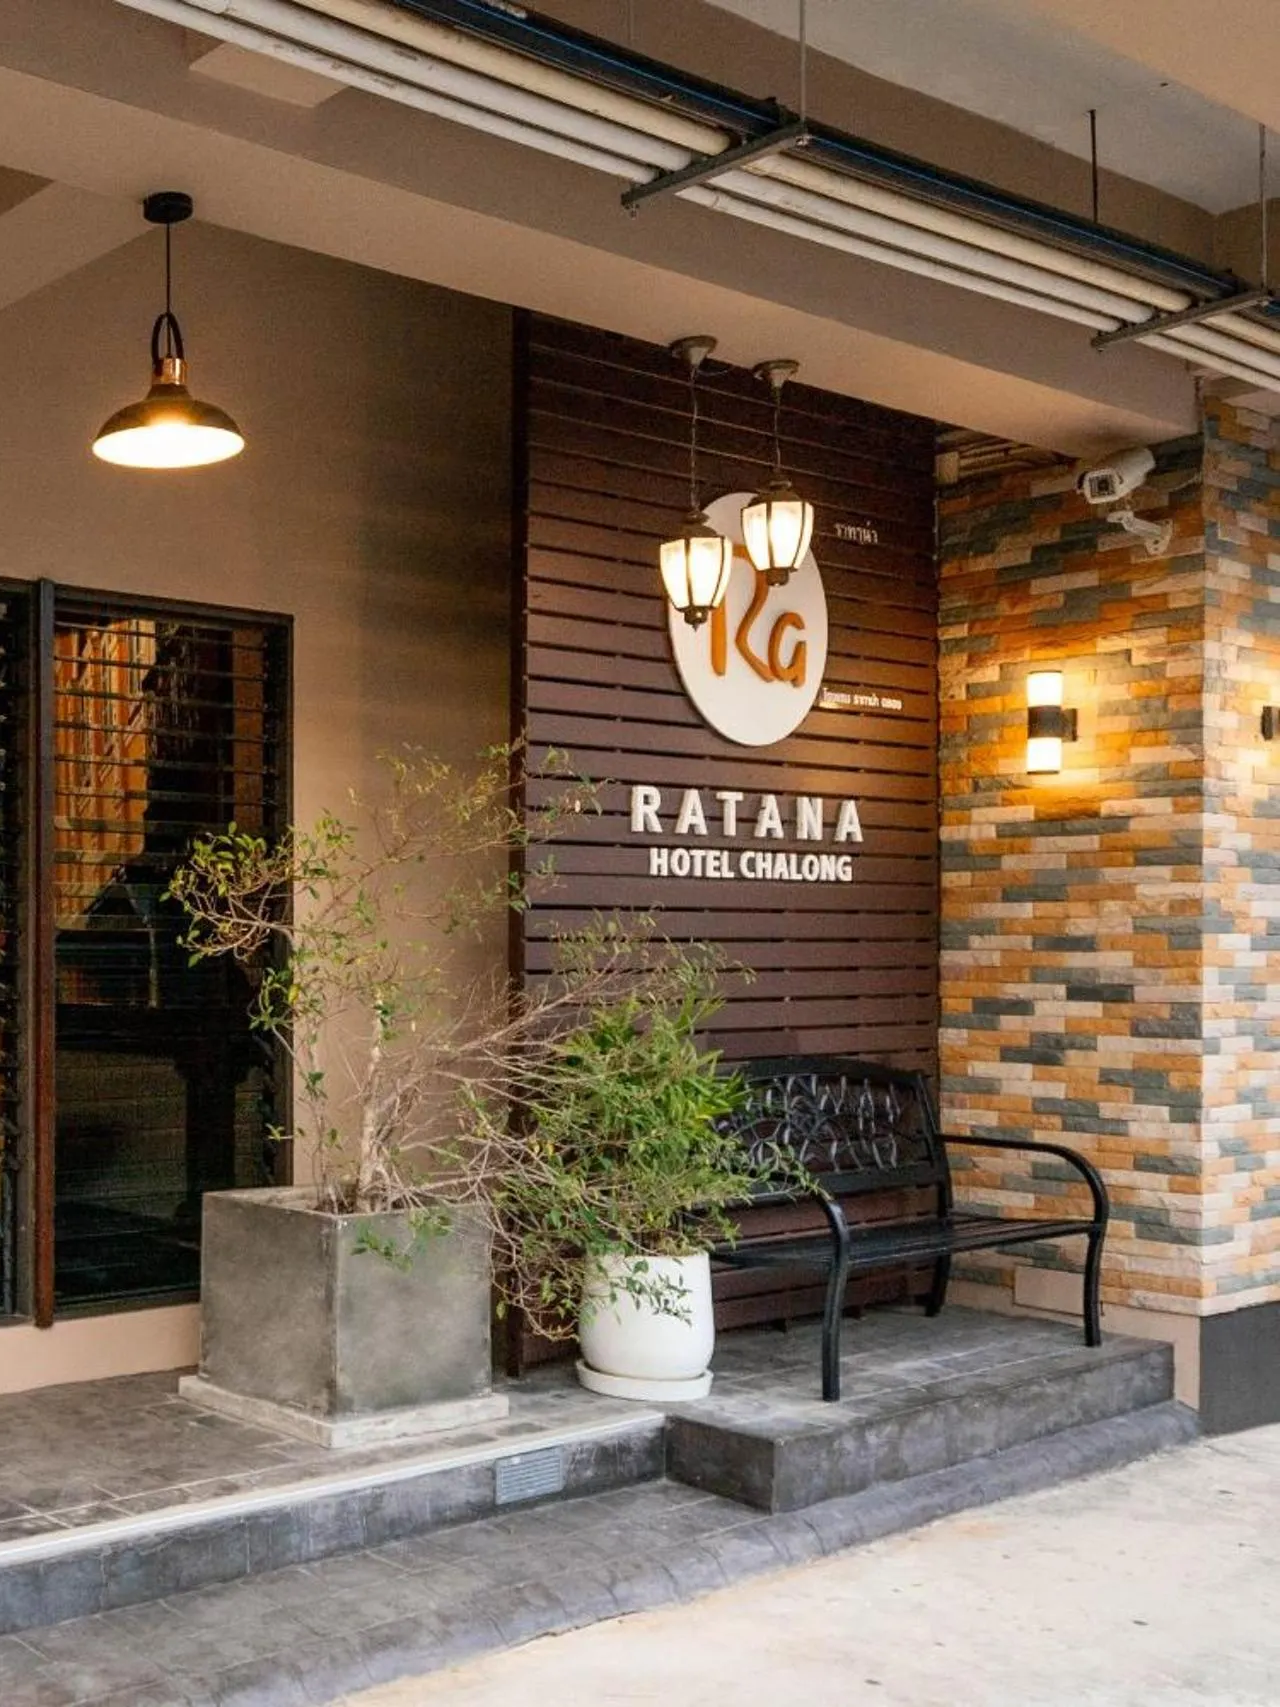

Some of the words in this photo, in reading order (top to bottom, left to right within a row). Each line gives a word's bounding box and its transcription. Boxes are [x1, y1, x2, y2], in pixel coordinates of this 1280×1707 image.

[630, 785, 864, 842] RATANA
[649, 847, 735, 878] HOTEL
[739, 850, 854, 882] CHALONG
